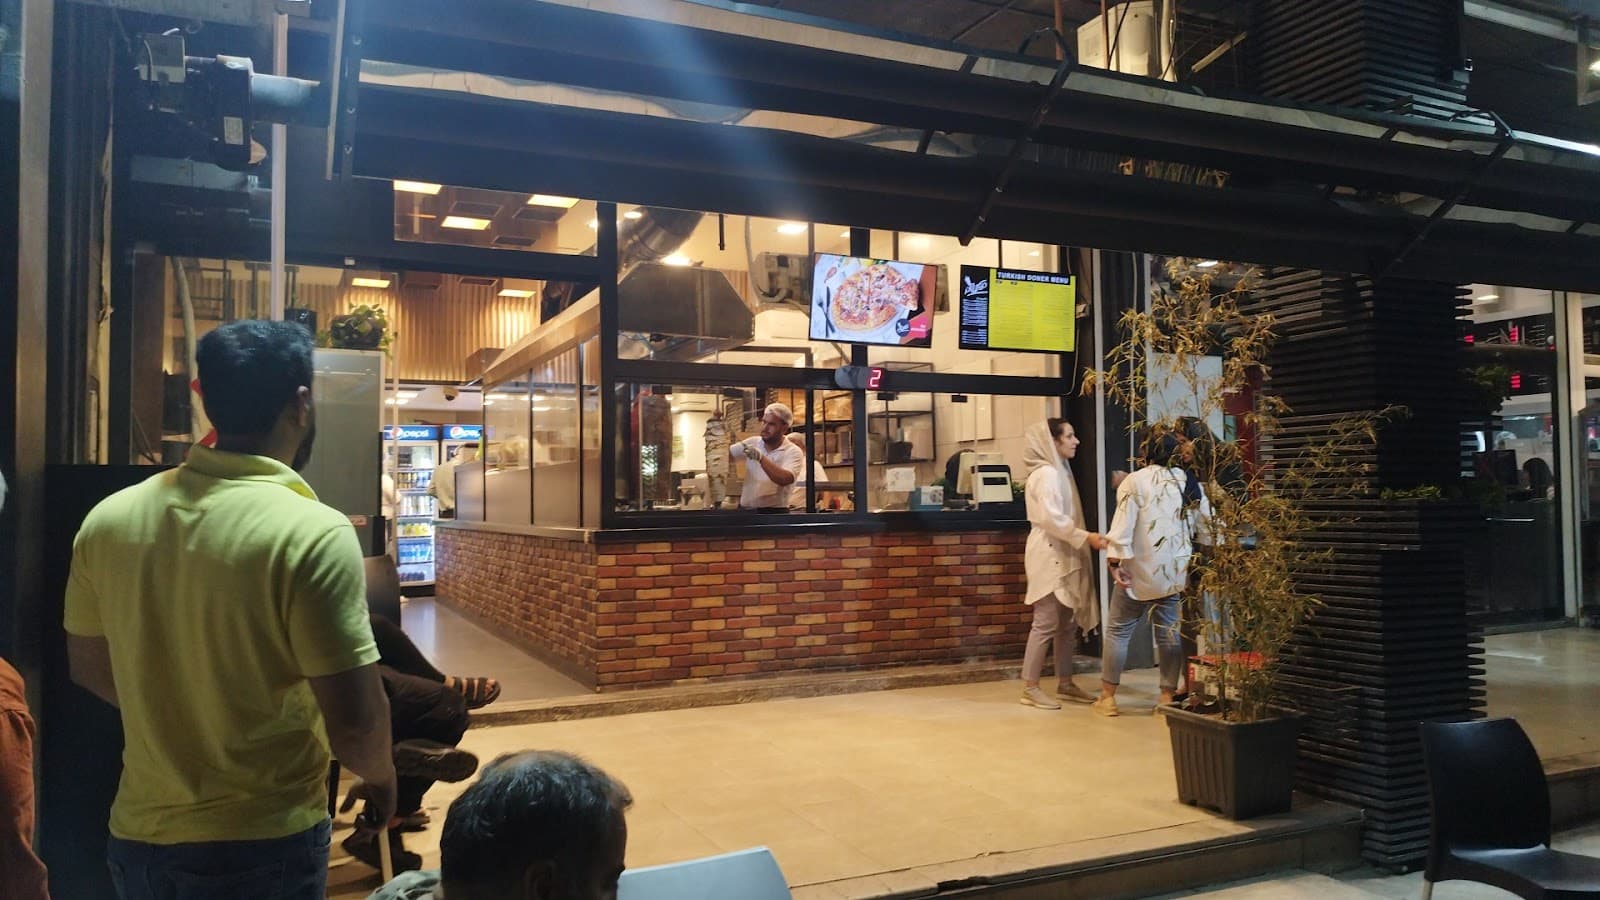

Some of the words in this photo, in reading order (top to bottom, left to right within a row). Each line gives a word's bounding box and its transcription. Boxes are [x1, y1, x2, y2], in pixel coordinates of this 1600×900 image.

[997, 271, 1026, 281] TURKISH
[1026, 274, 1049, 283] DONER
[1050, 276, 1069, 284] MENU
[869, 369, 882, 388] 2
[402, 429, 429, 439] pepsi
